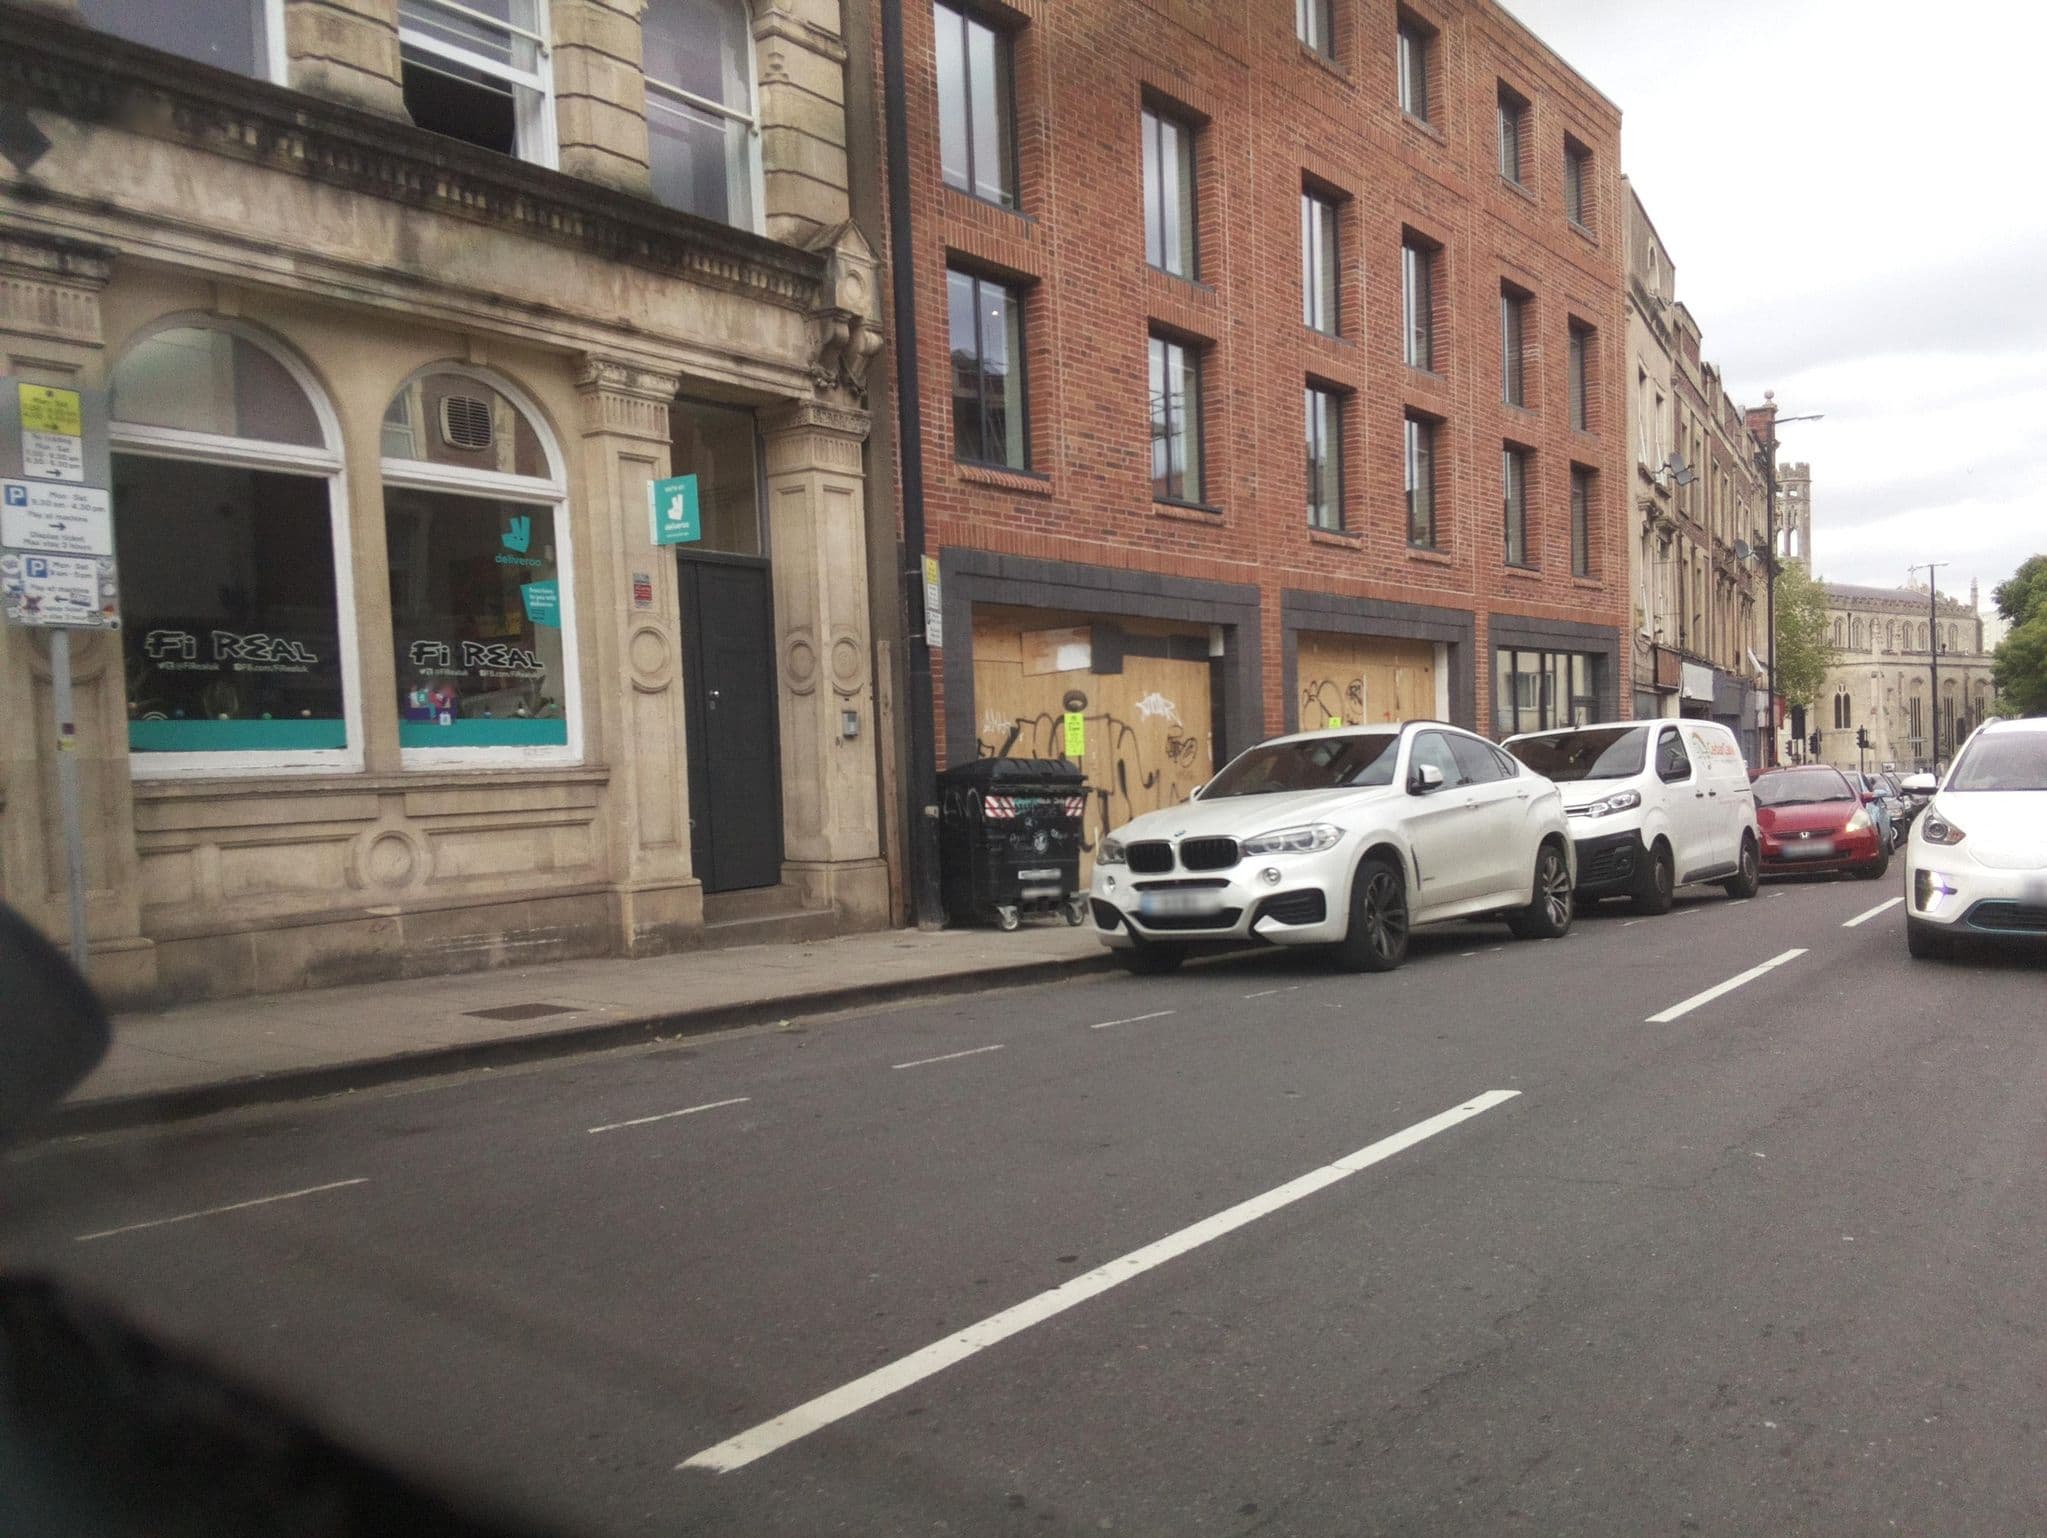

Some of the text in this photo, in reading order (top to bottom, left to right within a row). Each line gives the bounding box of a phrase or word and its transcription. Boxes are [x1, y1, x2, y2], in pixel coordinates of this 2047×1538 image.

[10, 487, 25, 505] P
[32, 561, 45, 577] P
[495, 553, 542, 567] deliveroo
[144, 630, 196, 660] Fi
[410, 641, 545, 669] Fi REAL
